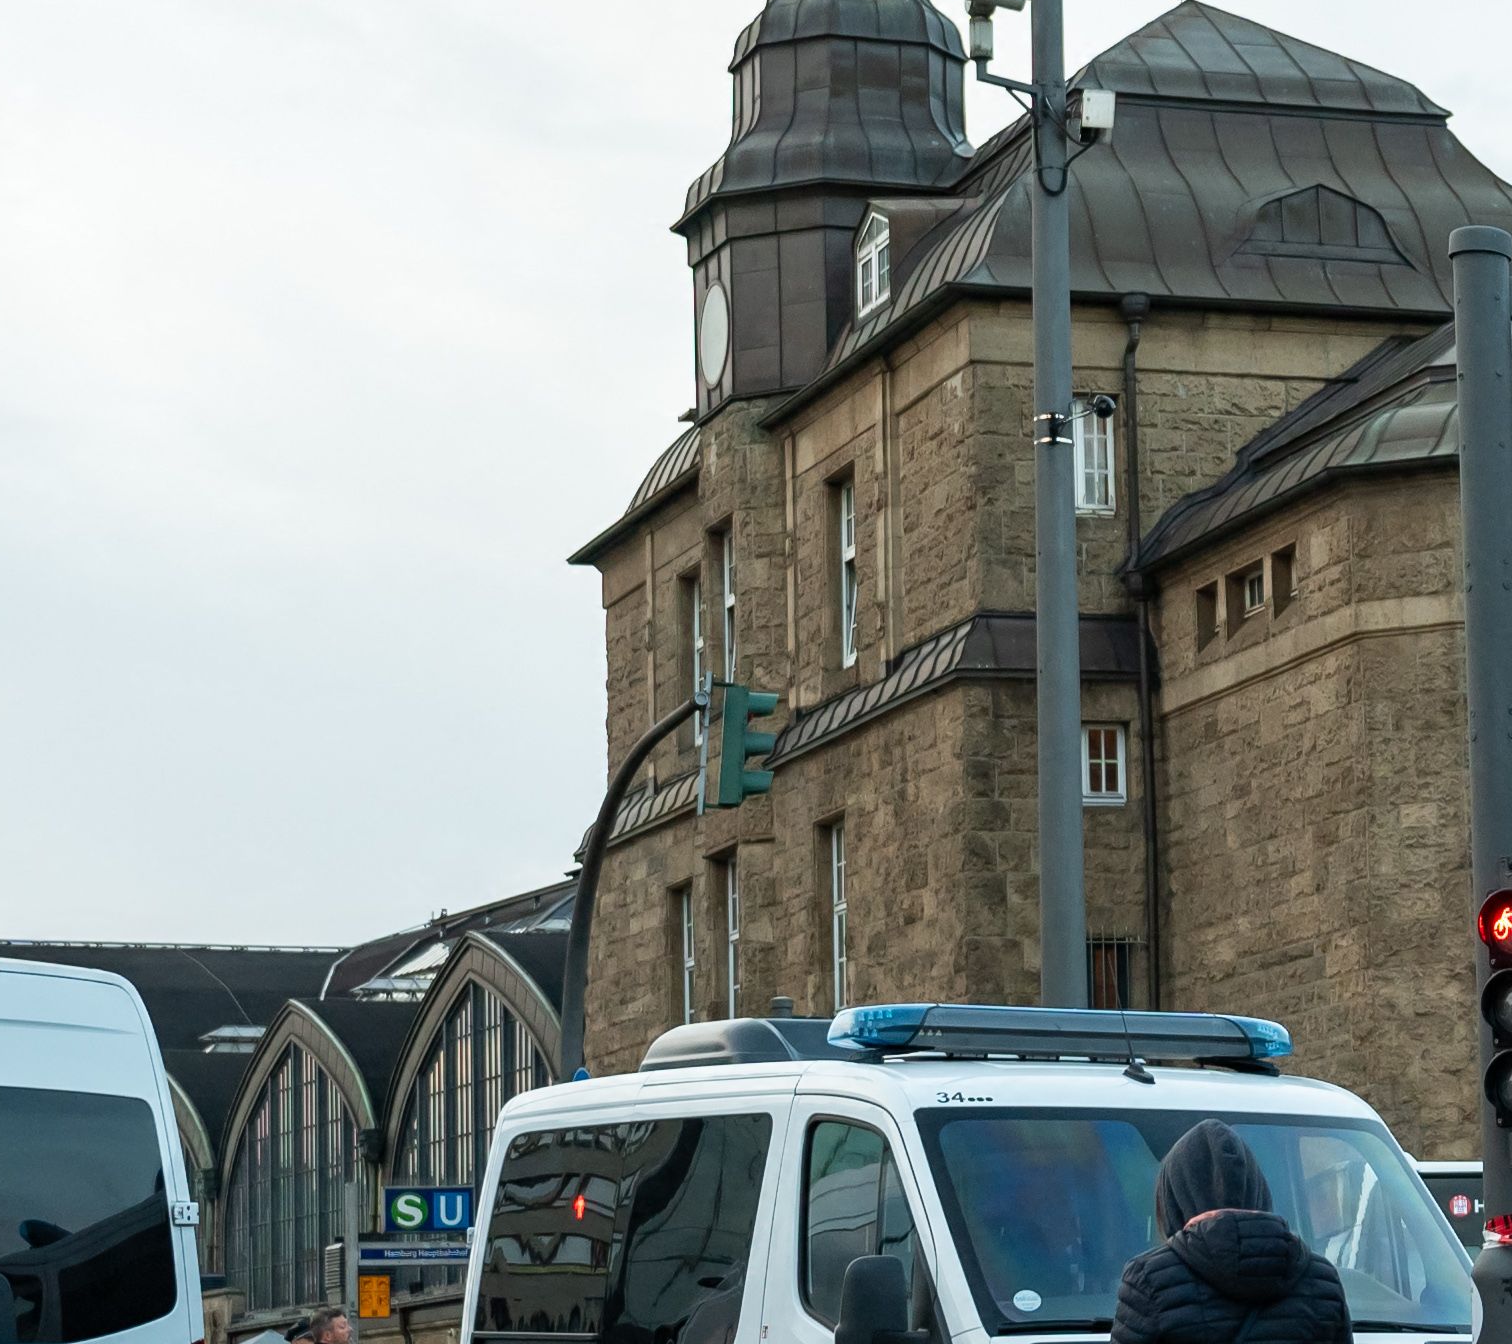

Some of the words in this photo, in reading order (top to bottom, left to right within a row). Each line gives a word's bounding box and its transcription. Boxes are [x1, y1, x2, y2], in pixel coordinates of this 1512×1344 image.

[396, 1194, 424, 1227] S
[439, 1194, 463, 1226] U
[384, 1250, 418, 1259] Hamburg
[418, 1249, 468, 1259] Hauptbahnhof
